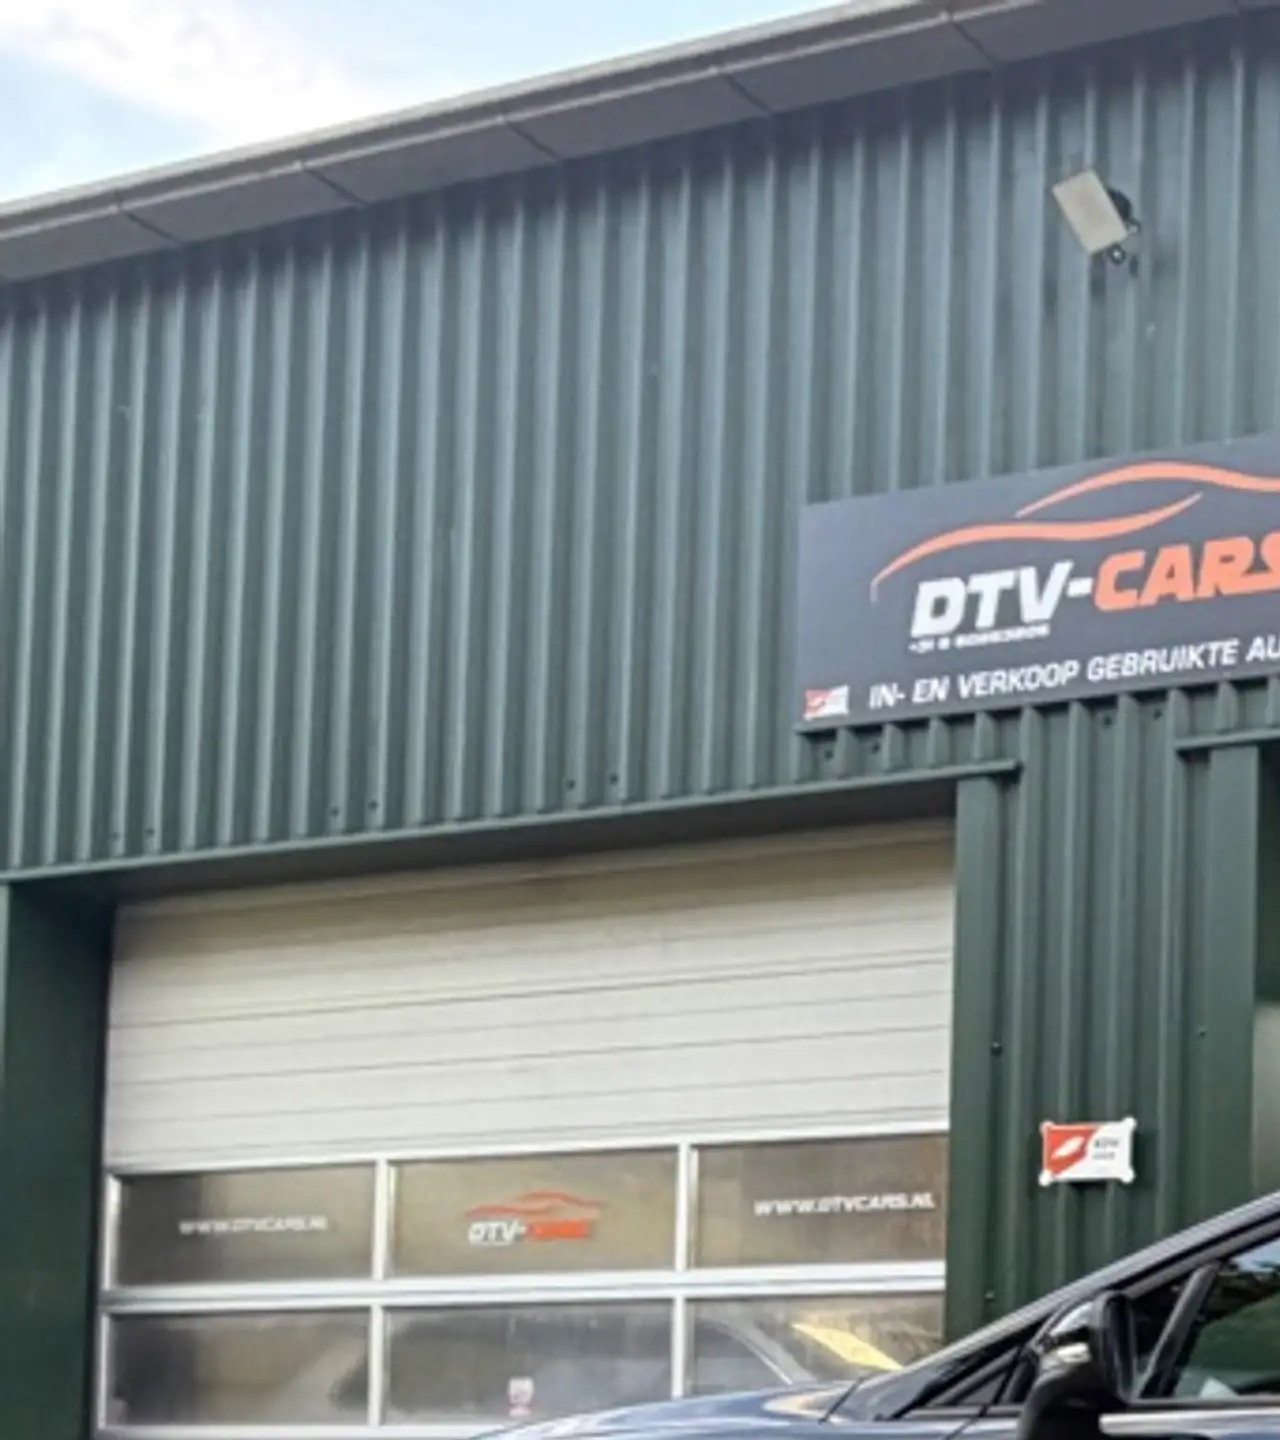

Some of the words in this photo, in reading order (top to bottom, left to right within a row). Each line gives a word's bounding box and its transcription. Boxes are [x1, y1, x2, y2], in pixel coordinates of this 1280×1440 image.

[868, 682, 905, 709] IN-
[912, 675, 950, 704] EN
[957, 658, 1080, 699] VERKOOP
[1086, 637, 1240, 682] GEBRUIKTE
[468, 1219, 592, 1244] DTV-
